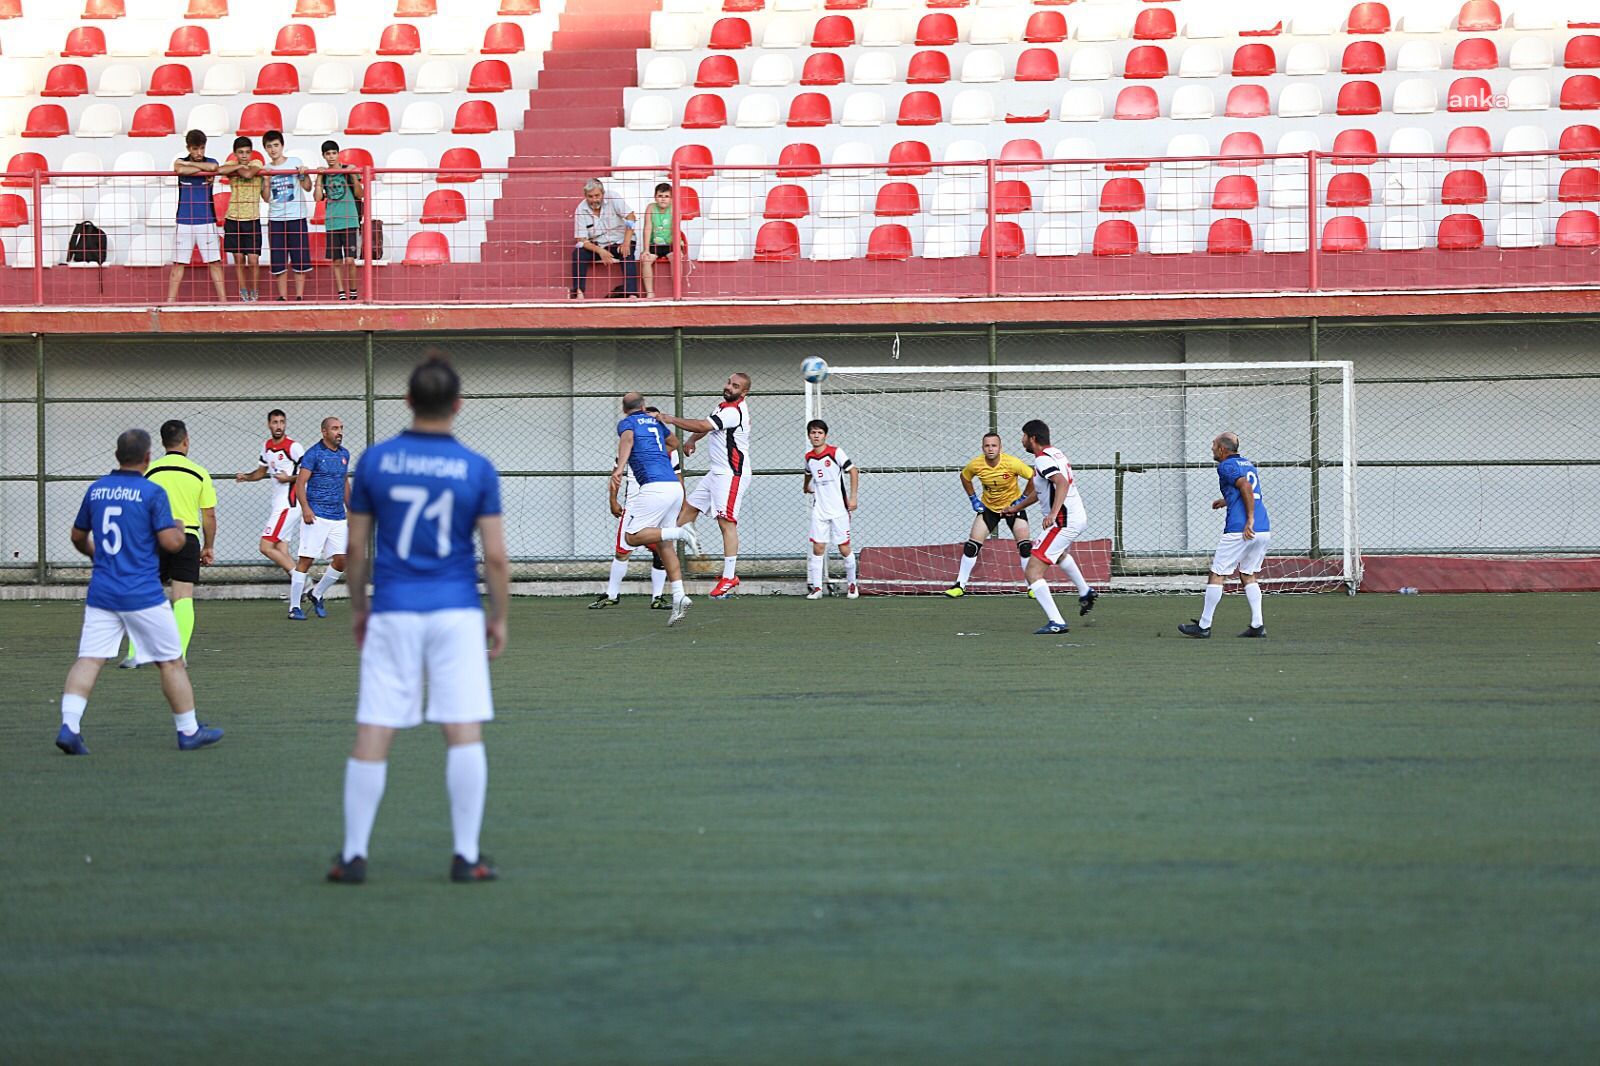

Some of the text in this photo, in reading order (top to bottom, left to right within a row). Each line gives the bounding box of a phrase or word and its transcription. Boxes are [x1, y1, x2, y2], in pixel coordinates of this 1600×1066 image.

[647, 427, 663, 451] 7
[380, 448, 406, 474] ALİ
[817, 469, 824, 478] 5
[90, 485, 143, 502] ERTUĞRUL
[1246, 471, 1261, 499] 2
[102, 506, 122, 555] 5
[389, 485, 454, 560] 71
